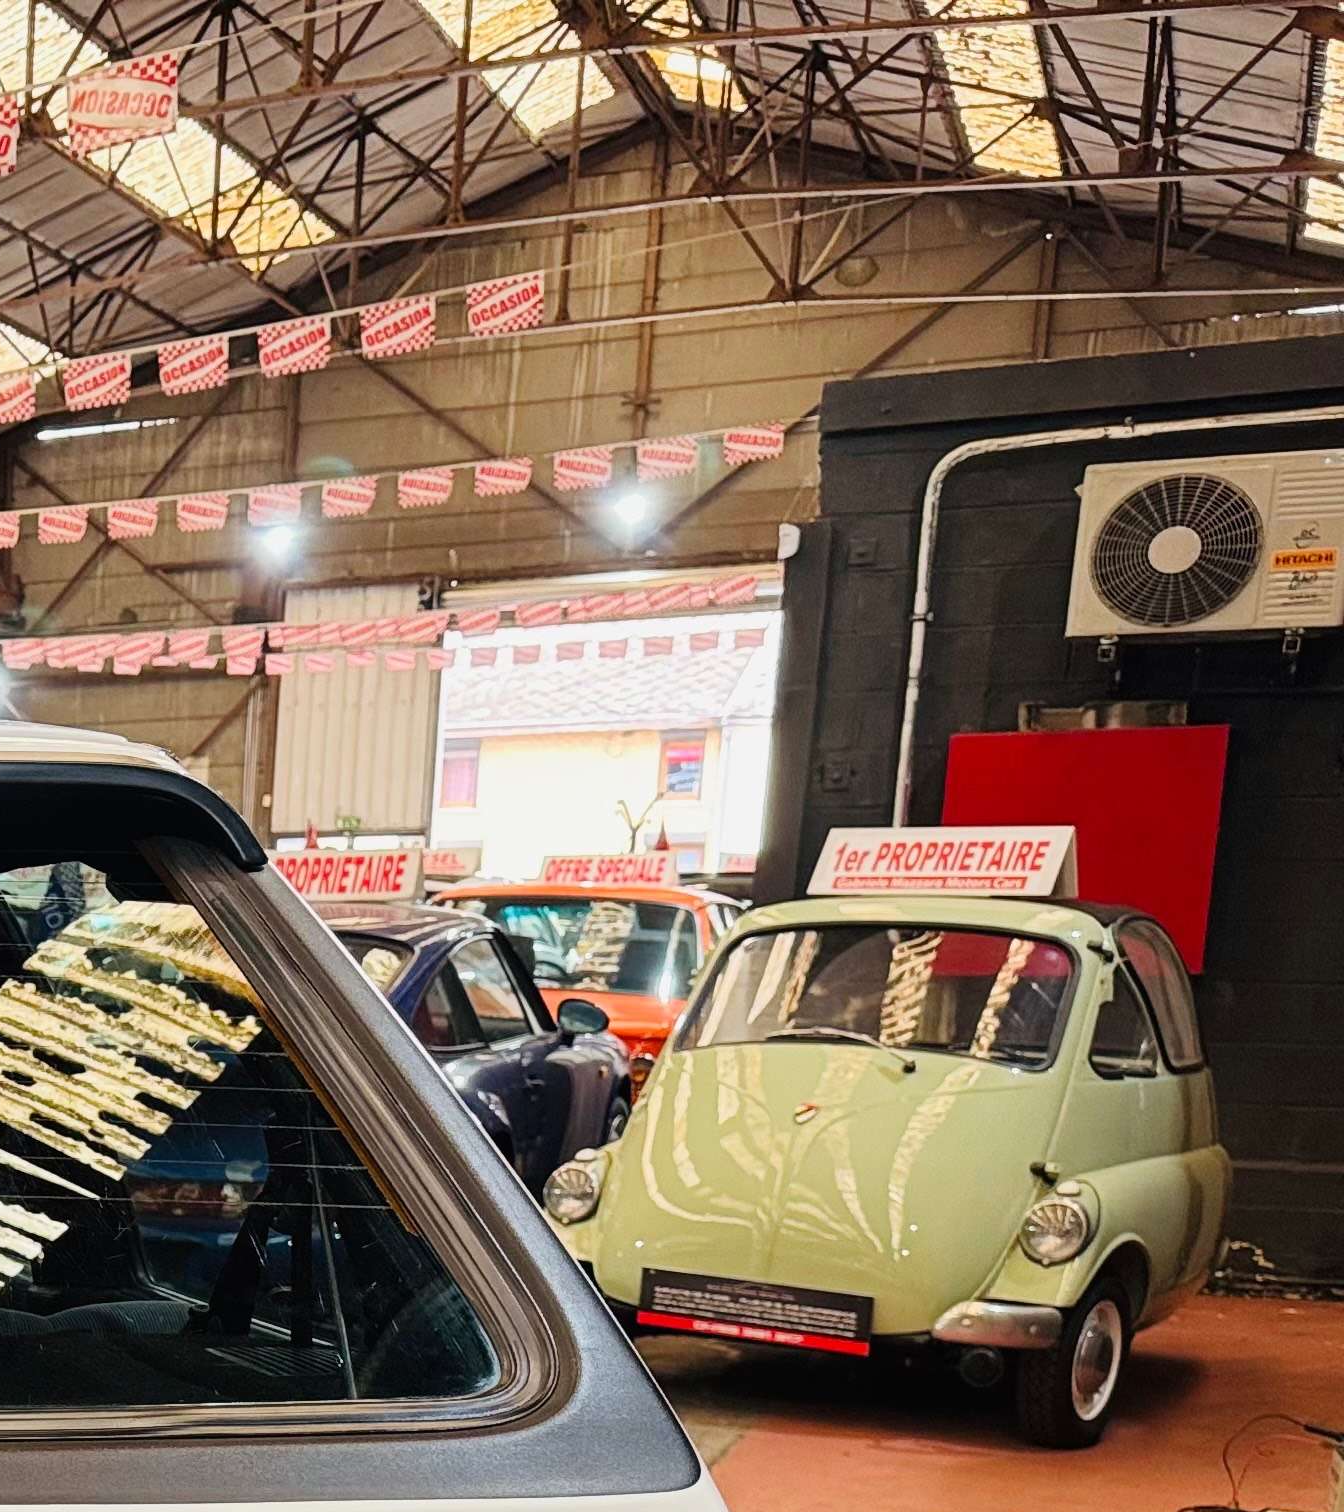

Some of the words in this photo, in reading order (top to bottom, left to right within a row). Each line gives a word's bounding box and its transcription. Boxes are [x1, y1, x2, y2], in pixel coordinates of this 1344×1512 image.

[471, 283, 541, 327] OCCASION
[365, 305, 433, 347] OCCASION
[163, 346, 226, 385] OCCASION
[263, 326, 327, 367] OCCASION
[67, 363, 127, 399] OCCASION
[1273, 551, 1335, 568] HITACHI
[833, 842, 869, 872] 1er
[872, 840, 1051, 872] PROPRIETAIRE
